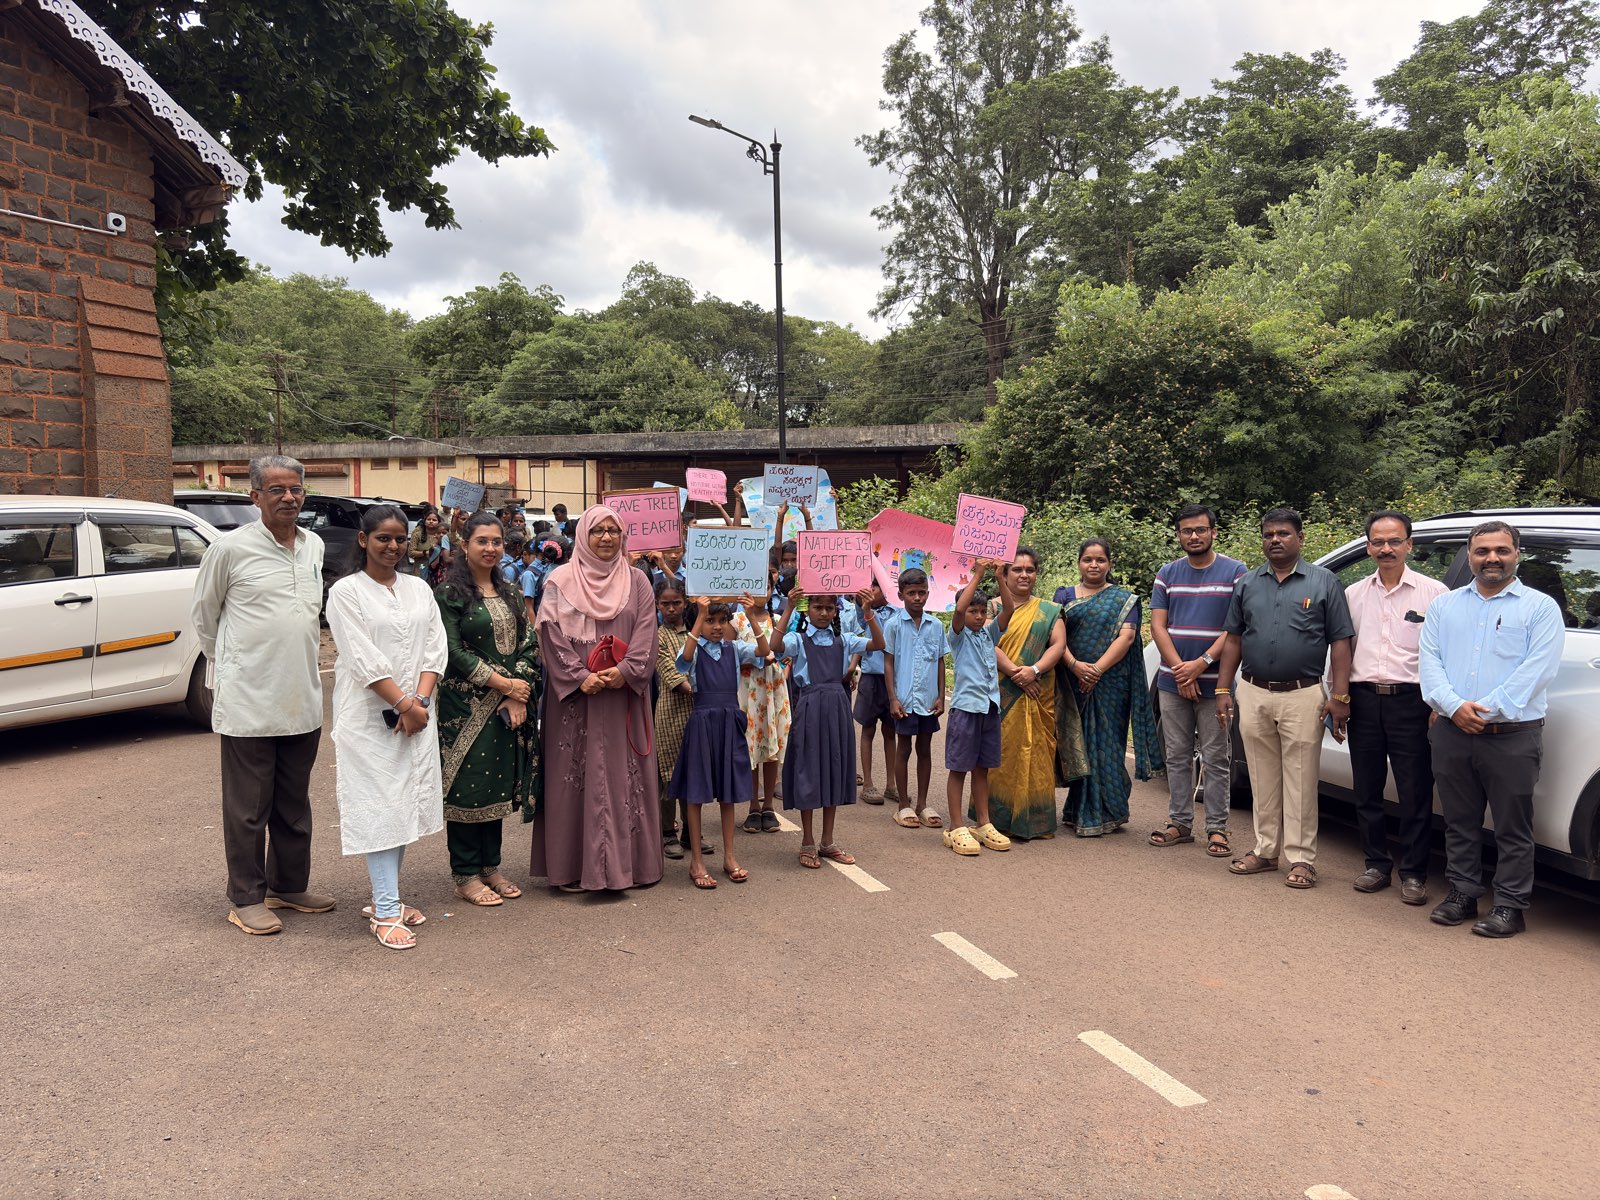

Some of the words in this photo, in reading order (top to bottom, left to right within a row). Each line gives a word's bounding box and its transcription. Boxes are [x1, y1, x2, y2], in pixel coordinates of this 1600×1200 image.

[769, 466, 795, 476] ಪರಿಸರ
[609, 498, 641, 513] SAVE
[643, 496, 676, 511] TREE
[642, 519, 679, 536] EARTH
[960, 524, 1008, 545] ನಿಜವಾದ
[695, 532, 738, 550] ಪರಿಸರ
[740, 537, 766, 552] ನಾಶ
[804, 536, 853, 551] NATURE
[855, 537, 870, 551] IS
[963, 540, 1007, 557] ಅನ್ನದಾತೆ
[691, 556, 747, 571] ಮನುಕುಲ
[809, 554, 848, 572] GIFT
[709, 575, 764, 590] ಸರ್ವನಾಶ
[821, 573, 851, 591] GOD
